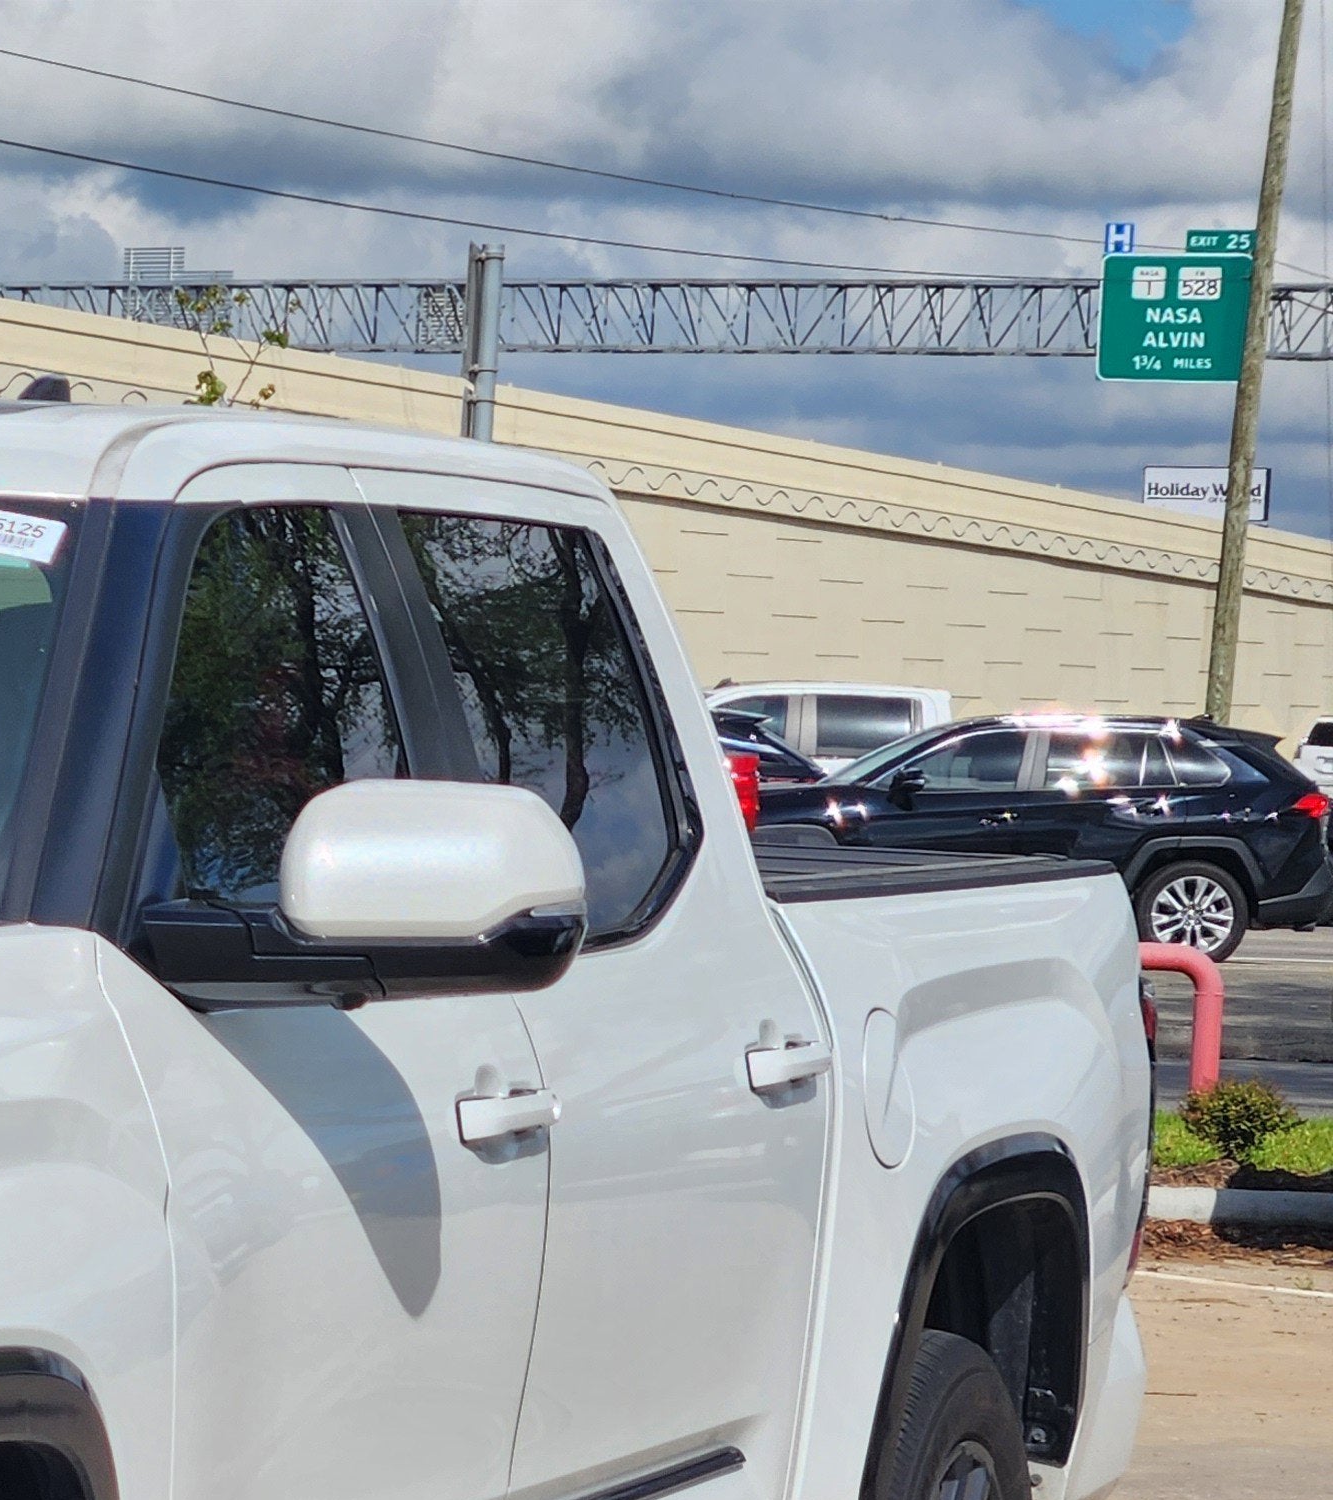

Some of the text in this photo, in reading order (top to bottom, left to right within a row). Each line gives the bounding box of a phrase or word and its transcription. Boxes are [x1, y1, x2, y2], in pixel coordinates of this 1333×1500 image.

[1189, 233, 1251, 250] EXIT 25
[1181, 279, 1218, 296] 528
[1145, 306, 1203, 324] NASA
[1141, 330, 1206, 348] ALVIN
[1172, 357, 1212, 369] MILES
[1146, 482, 1209, 498] Holiday
